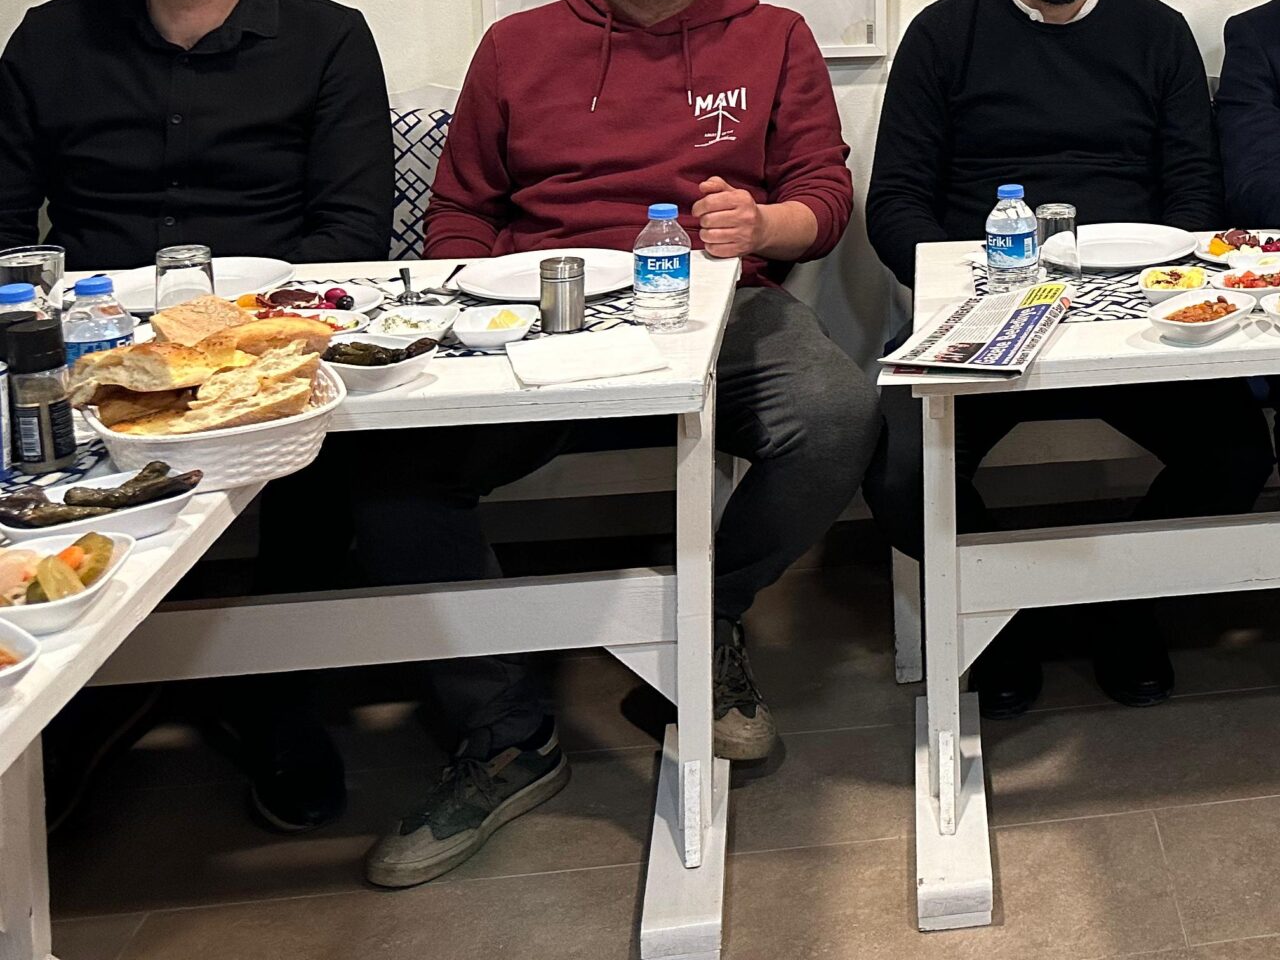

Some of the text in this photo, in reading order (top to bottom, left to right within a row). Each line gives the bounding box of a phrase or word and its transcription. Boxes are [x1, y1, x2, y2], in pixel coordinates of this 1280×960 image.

[694, 87, 746, 117] MAVI
[988, 234, 1013, 247] Erikli
[647, 257, 680, 270] Erikli
[973, 340, 1012, 365] Gazete
